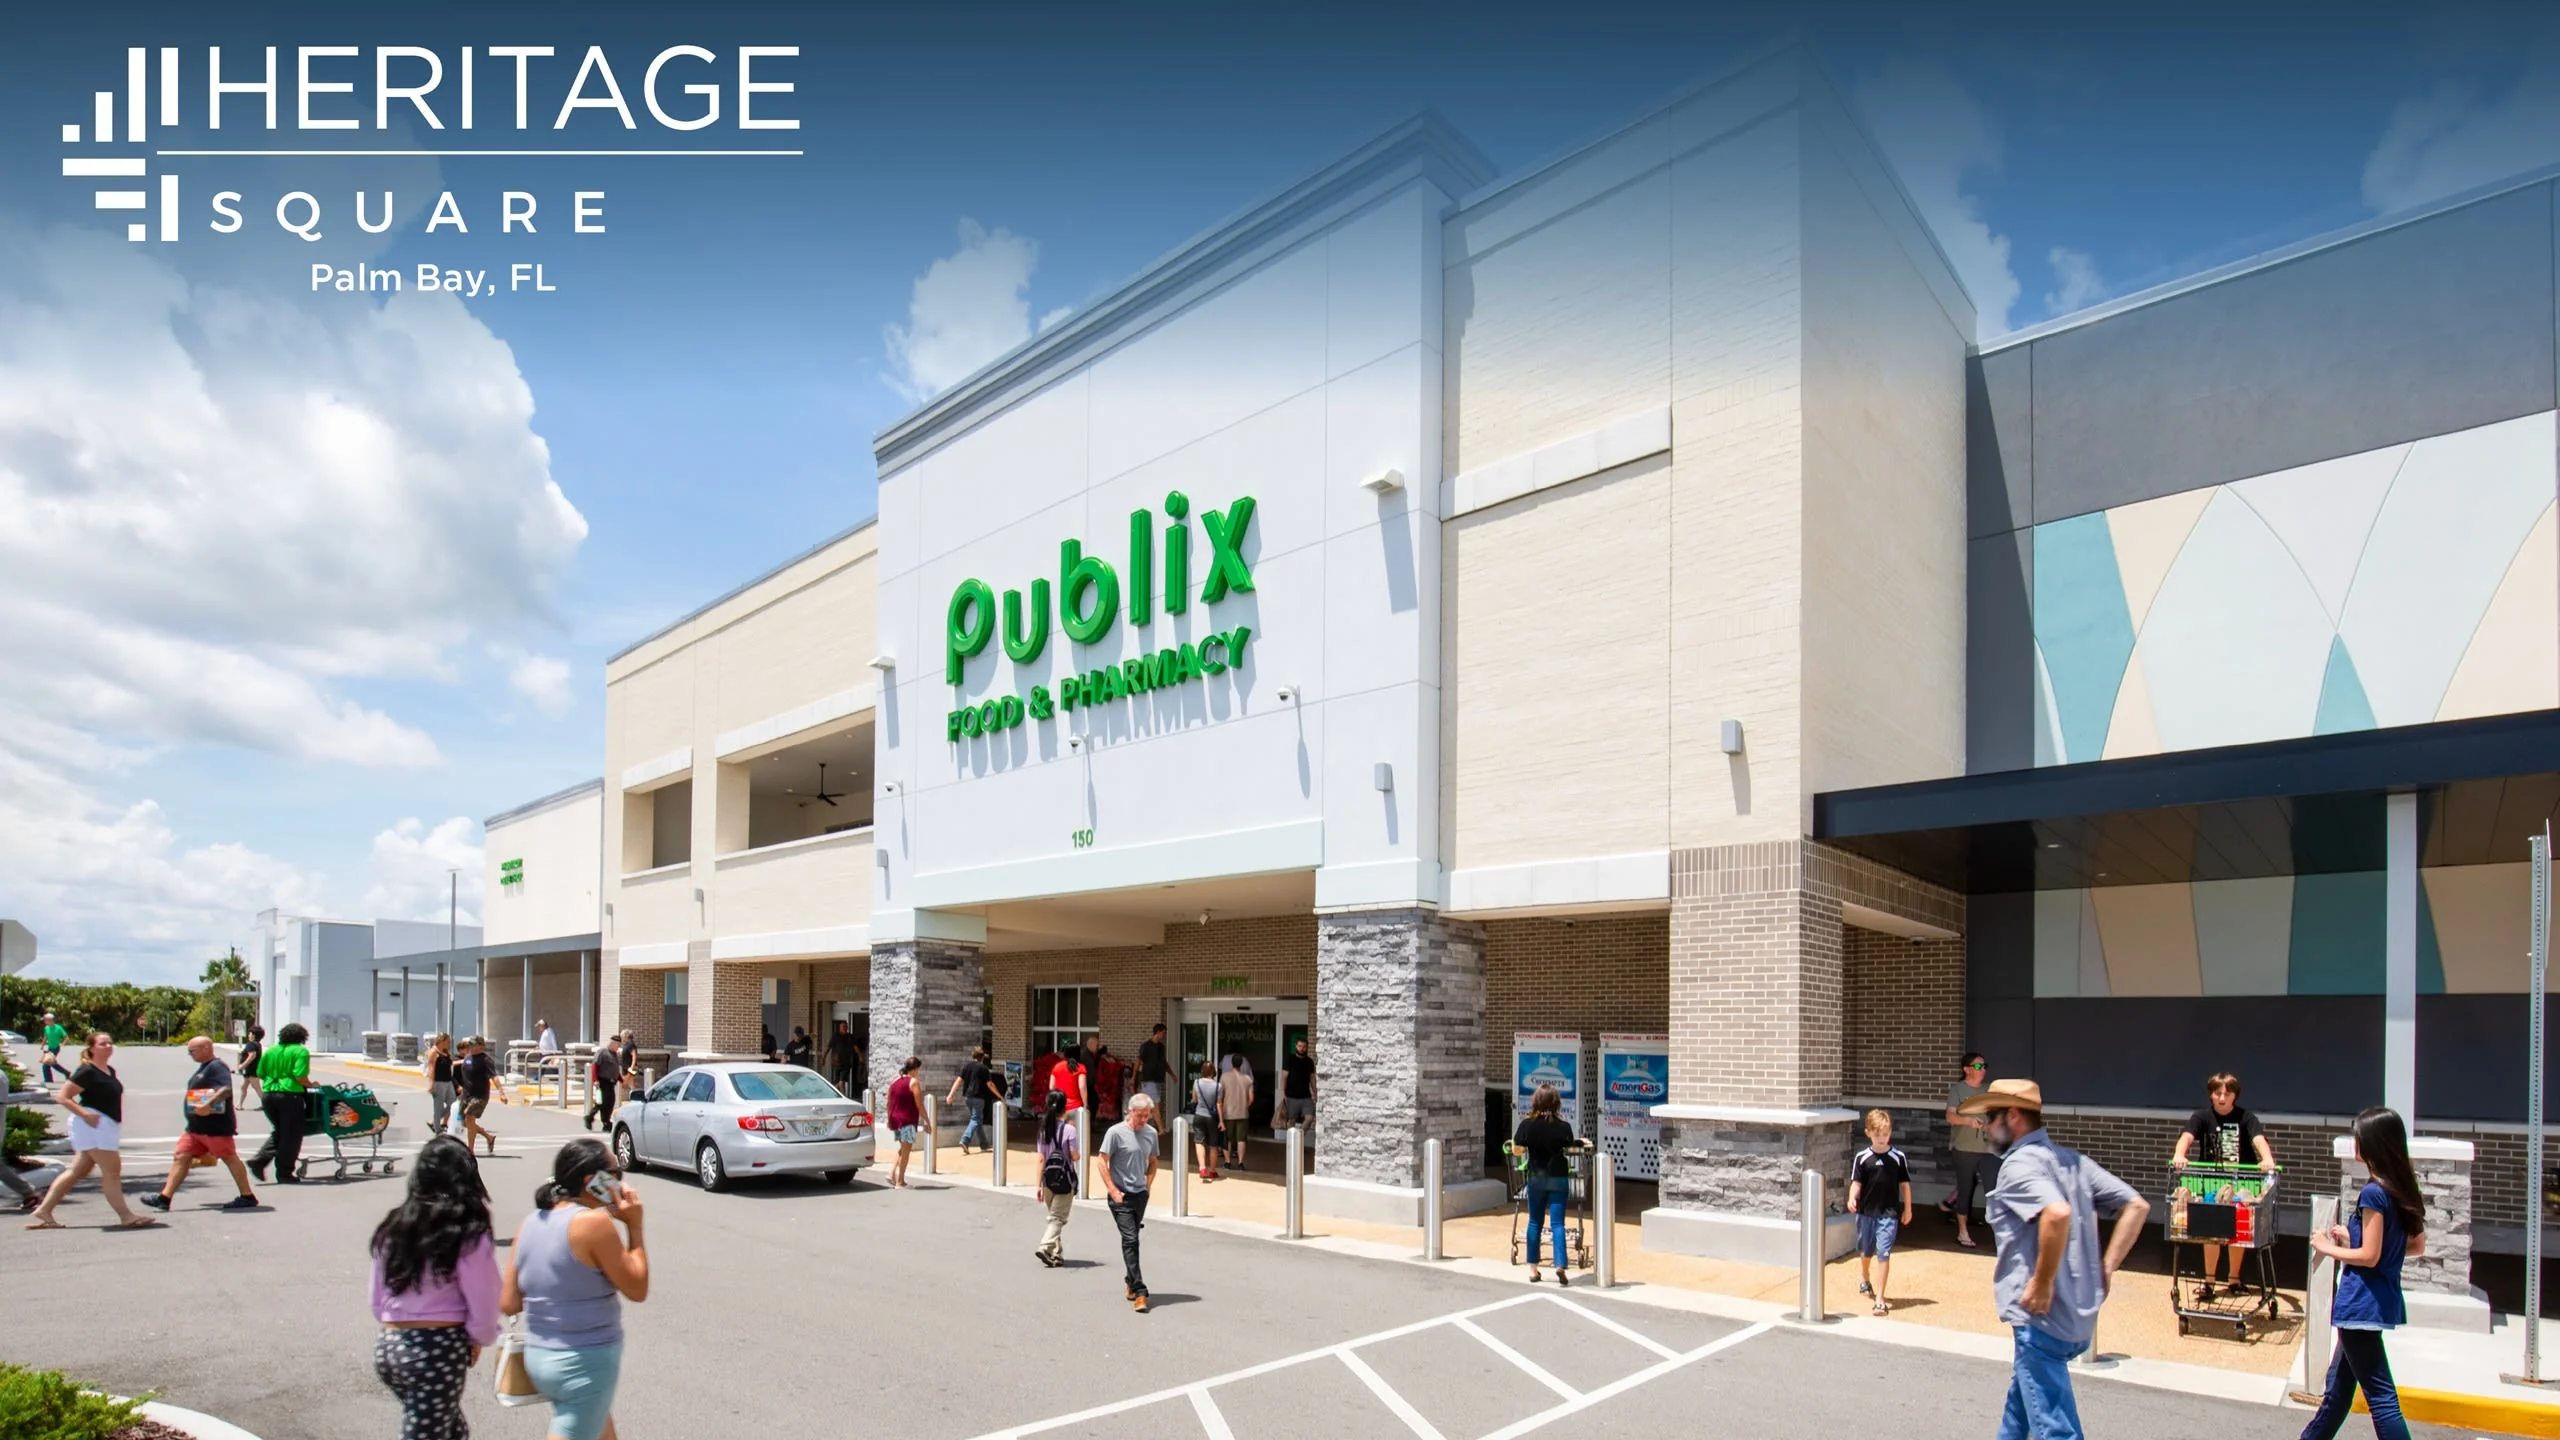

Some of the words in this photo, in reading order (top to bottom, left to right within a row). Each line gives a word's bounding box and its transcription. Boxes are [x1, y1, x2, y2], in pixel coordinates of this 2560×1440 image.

[946, 489, 1256, 687] Publix
[947, 694, 1026, 743] FOOD
[1028, 685, 1054, 720] &
[1059, 626, 1252, 713] PHARMACY
[1072, 829, 1093, 848] 150
[1222, 1013, 1274, 1025] elcom
[1611, 1081, 1661, 1093] AmeriGas
